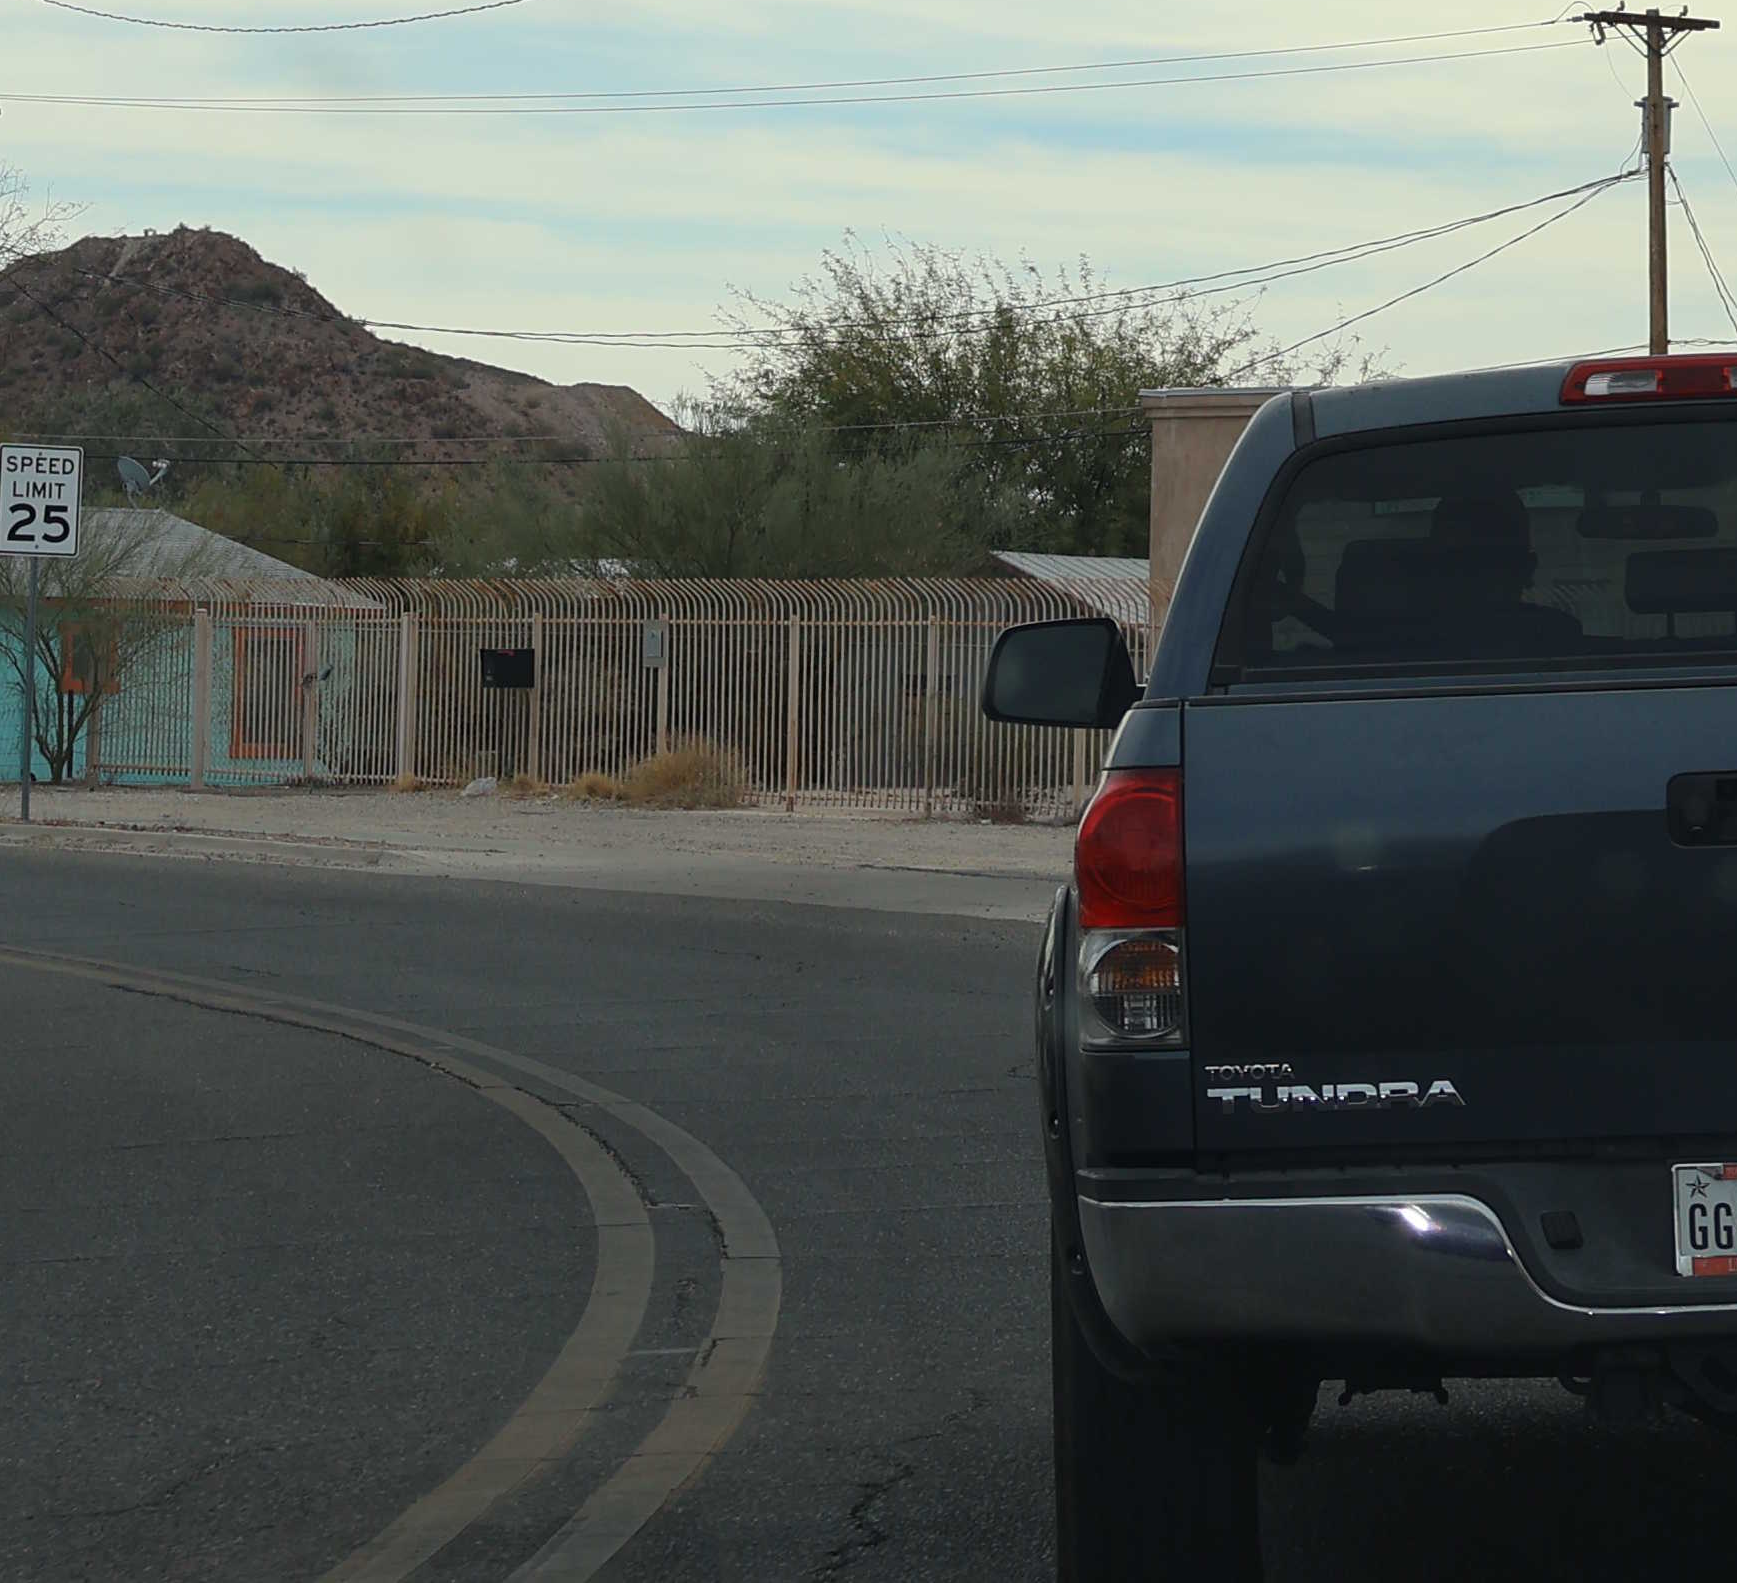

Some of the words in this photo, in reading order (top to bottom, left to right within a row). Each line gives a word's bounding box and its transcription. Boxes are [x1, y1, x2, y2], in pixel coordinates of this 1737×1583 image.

[6, 456, 74, 474] SPEED
[13, 481, 66, 499] LIMIT
[7, 503, 70, 543] 25
[1205, 1064, 1294, 1080] TOYOTA
[1207, 1080, 1466, 1113] TUNDRA
